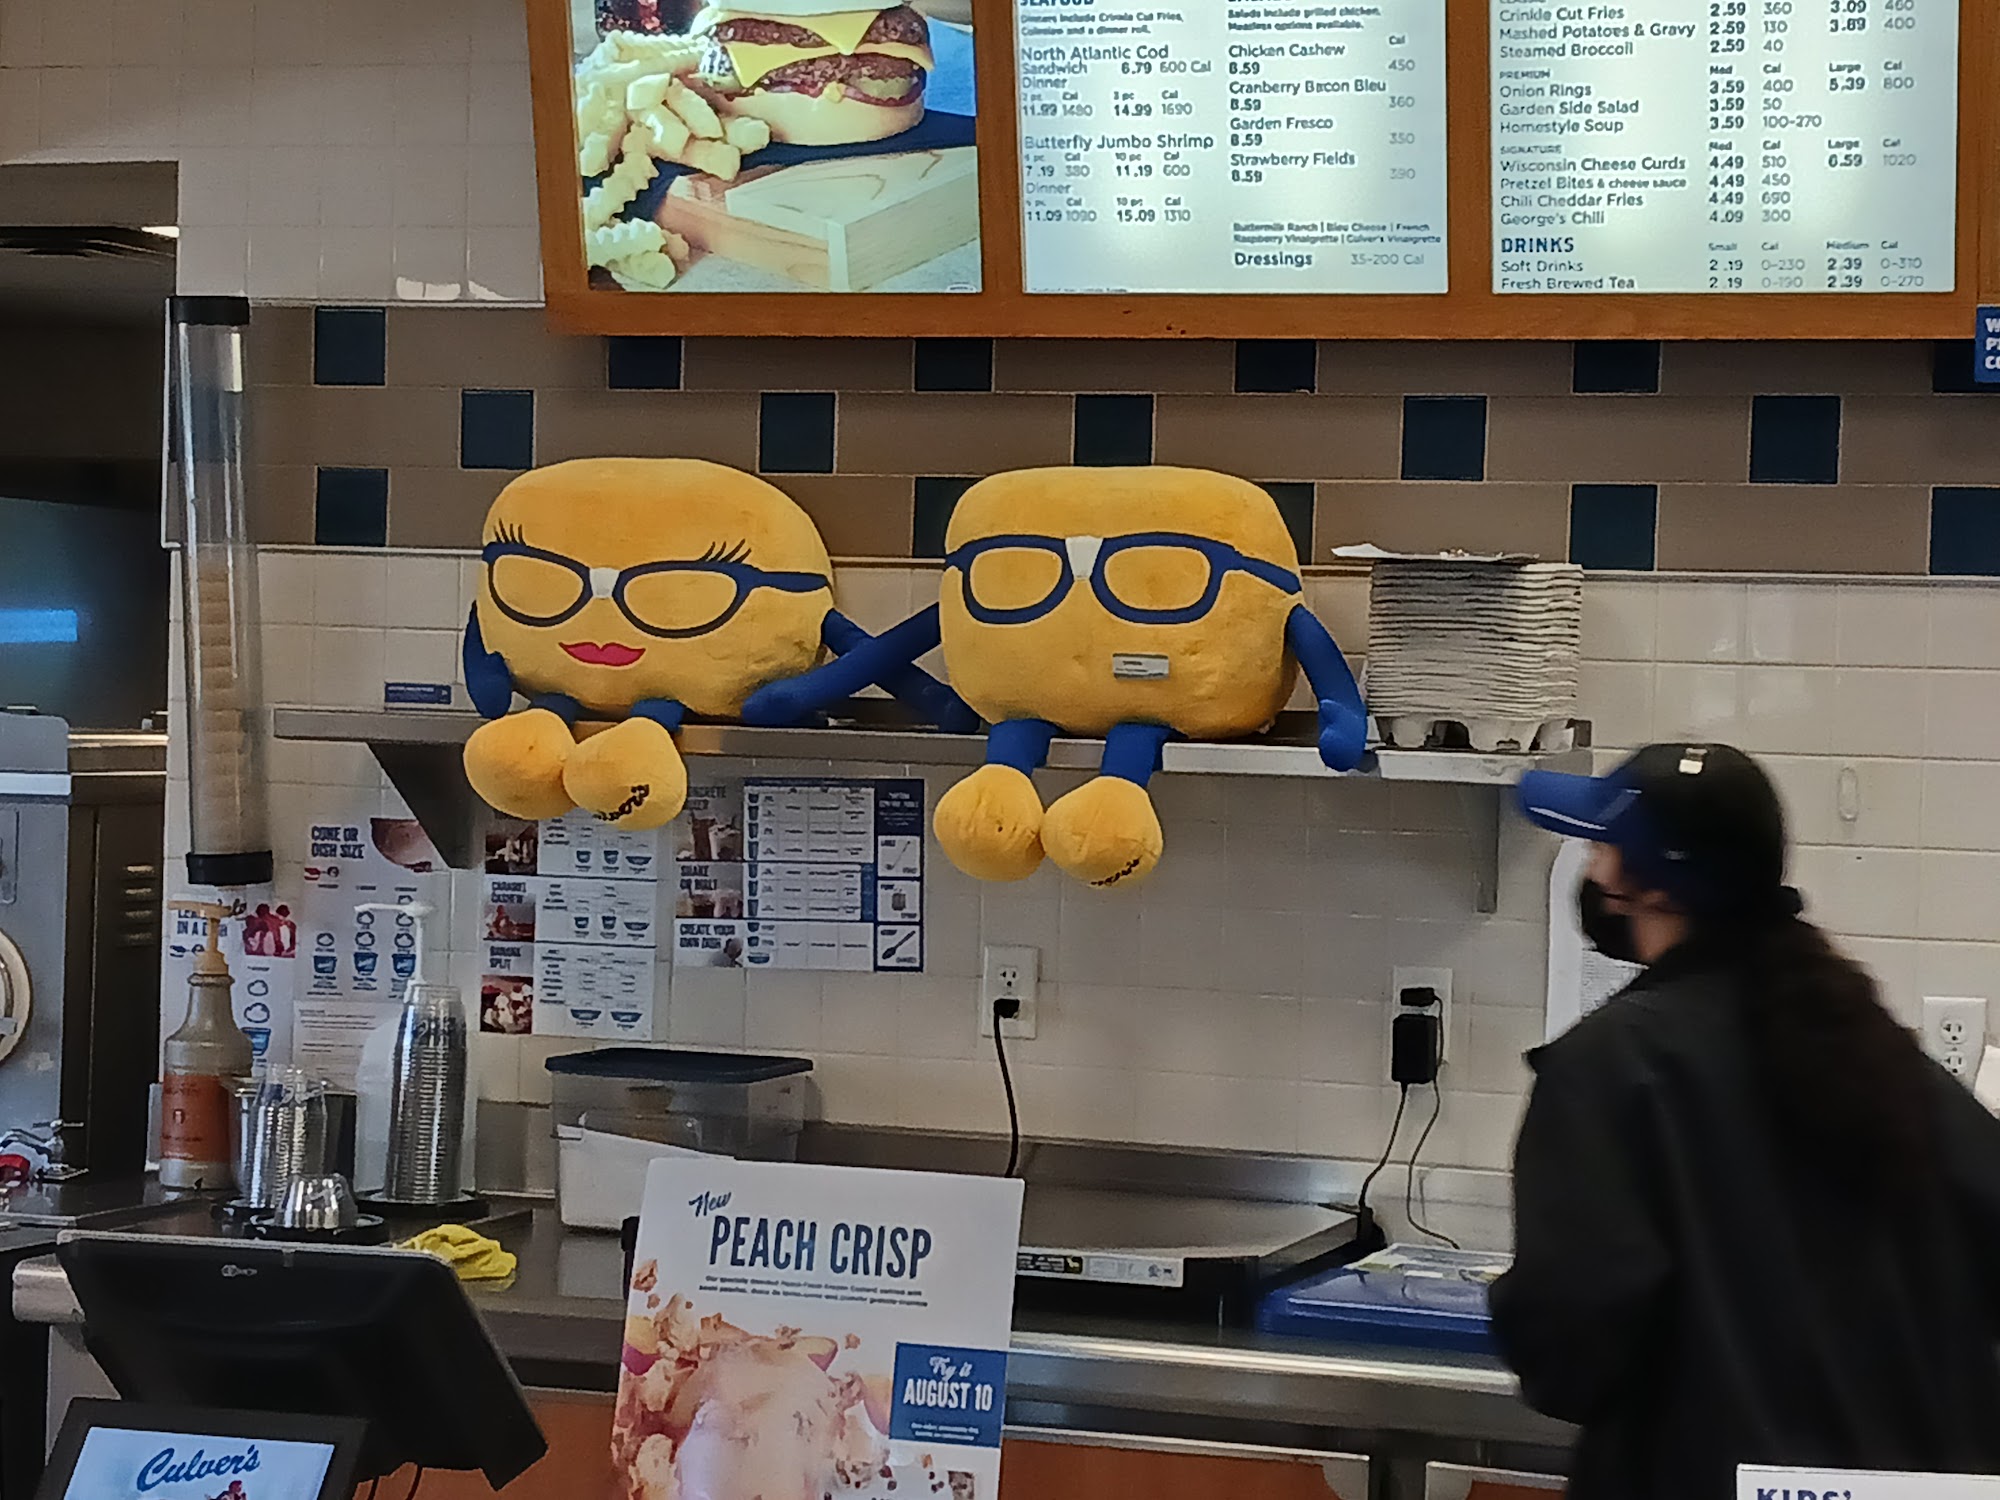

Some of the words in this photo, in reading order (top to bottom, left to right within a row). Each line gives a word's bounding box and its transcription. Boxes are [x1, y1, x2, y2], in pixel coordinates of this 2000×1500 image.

[1500, 9, 1552, 22] Crinkle
[1556, 7, 1583, 21] Cut
[1588, 5, 1624, 20] Fries
[1710, 2, 1746, 17] 2.59
[1764, 1, 1793, 15] 360
[1710, 21, 1745, 35] 2.59
[1884, 17, 1915, 30] 400
[1500, 25, 1557, 39] Mashed
[1562, 25, 1629, 39] Potatoes
[1634, 23, 1644, 36] &
[1650, 23, 1696, 38] Gravy
[1021, 47, 1065, 61] North
[1070, 46, 1131, 60] Atlantic
[1136, 44, 1169, 59] Cod
[1228, 45, 1285, 58] Chicken
[1289, 43, 1345, 57] Cashew
[1500, 44, 1566, 58] Steamed
[1571, 41, 1633, 56] Broccoli
[1710, 39, 1745, 53] 2.59
[1763, 39, 1784, 52] 40
[1022, 60, 1087, 75] Sandwich
[1190, 60, 1211, 73] Cal
[1388, 59, 1415, 71] 450
[1763, 62, 1781, 74] Cal
[1829, 62, 1861, 73] Large
[1884, 61, 1902, 71] Cal
[1499, 68, 1550, 80] PREMIUM
[1022, 77, 1067, 89] Dinner
[1229, 81, 1300, 96] Cranberry
[1305, 80, 1350, 93] Bacon
[1354, 79, 1386, 92] Bleu
[1710, 80, 1745, 94] 3.59
[1763, 79, 1793, 93] 400
[1062, 92, 1078, 101] Cal
[1162, 90, 1179, 99] Cal
[1500, 84, 1545, 98] Onion
[1550, 84, 1592, 98] Rings
[1114, 104, 1152, 116] 14.99
[1500, 103, 1554, 116] Garden
[1559, 101, 1592, 115] Side
[1597, 100, 1639, 114] Salad
[1710, 97, 1745, 112] 3.59
[1762, 97, 1782, 110] 50
[1230, 117, 1281, 130] Garden
[1286, 117, 1333, 130] Fresco
[1500, 119, 1580, 135] Homestyle
[1584, 119, 1623, 133] Soup
[1710, 115, 1744, 130] 3.59
[1025, 134, 1093, 151] Butterfly
[1097, 135, 1152, 149] Jumbo
[1157, 134, 1214, 149] Shrimp
[1763, 140, 1781, 150] Cal
[1883, 138, 1900, 148] Cal
[1064, 152, 1081, 161] Cal
[1164, 151, 1179, 160] Cal
[1230, 153, 1309, 168] Strawberry
[1313, 152, 1356, 166] Fields
[1709, 155, 1744, 169] 4.49
[1883, 154, 1916, 166] 1020
[1026, 165, 1055, 177] 7.19
[1116, 164, 1152, 177] 11.19
[1500, 159, 1576, 172] Wisconsin
[1581, 158, 1636, 171] Cheese
[1641, 156, 1686, 170] Curds
[1026, 182, 1071, 194] Dinner
[1501, 177, 1551, 190] Pretzel
[1557, 176, 1593, 189] Bites
[1608, 178, 1650, 188] cheese
[1653, 179, 1686, 188] sauce
[1709, 174, 1745, 188] 4.49
[1066, 197, 1082, 206] Cal
[1165, 197, 1181, 206] Cal
[1501, 195, 1532, 207] Chili
[1537, 193, 1602, 207] Cheddar
[1607, 192, 1644, 206] Fries
[1709, 191, 1744, 205] 4.49
[1027, 209, 1062, 221] 11.09
[1117, 209, 1156, 222] 15.09
[1501, 213, 1566, 227] George's
[1572, 211, 1605, 224] Chili
[1709, 209, 1744, 223] 4.09
[1501, 237, 1574, 253] DRINKS
[1761, 242, 1779, 251] Cal
[1881, 241, 1899, 249] Cal
[1235, 252, 1313, 267] Dressings
[1403, 253, 1424, 265] Cal
[1501, 260, 1530, 272] Soft
[1537, 260, 1583, 272] Drinks
[1709, 259, 1743, 271] 2.19
[1827, 257, 1862, 271] 2.39
[1501, 277, 1541, 290] Fresh
[1547, 277, 1603, 290] Brewed
[1609, 276, 1635, 289] Tea
[1709, 276, 1742, 289] 2.19
[1827, 275, 1862, 288] 2.39
[689, 1191, 732, 1217] New
[709, 1215, 818, 1272] PEACH
[829, 1222, 933, 1279] CRISP
[929, 1355, 957, 1382] Try
[903, 1377, 971, 1410] AUGUST
[974, 1383, 993, 1412] 10
[136, 1444, 261, 1492] Culver's
